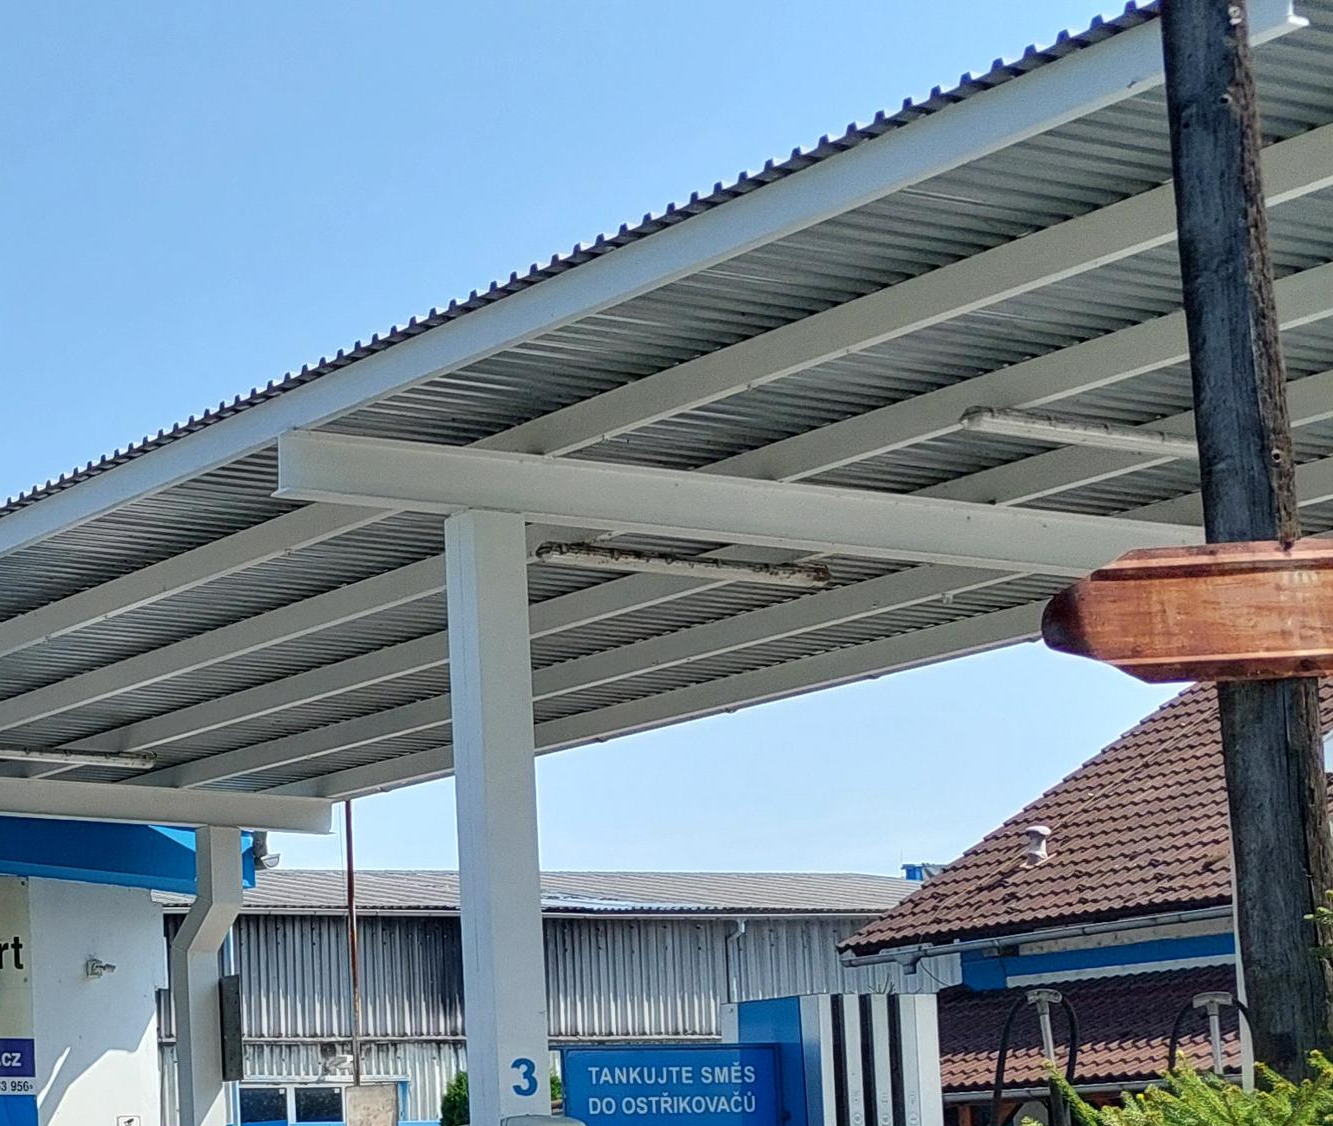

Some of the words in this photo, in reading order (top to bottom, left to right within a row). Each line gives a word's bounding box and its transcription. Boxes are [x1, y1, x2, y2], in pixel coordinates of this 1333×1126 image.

[511, 1058, 538, 1096] 3
[588, 1066, 693, 1085] TANKUJTE
[700, 1062, 755, 1083] SMĚS
[589, 1097, 615, 1114] DO
[622, 1091, 755, 1114] OSTŘIKOVAČŮ
